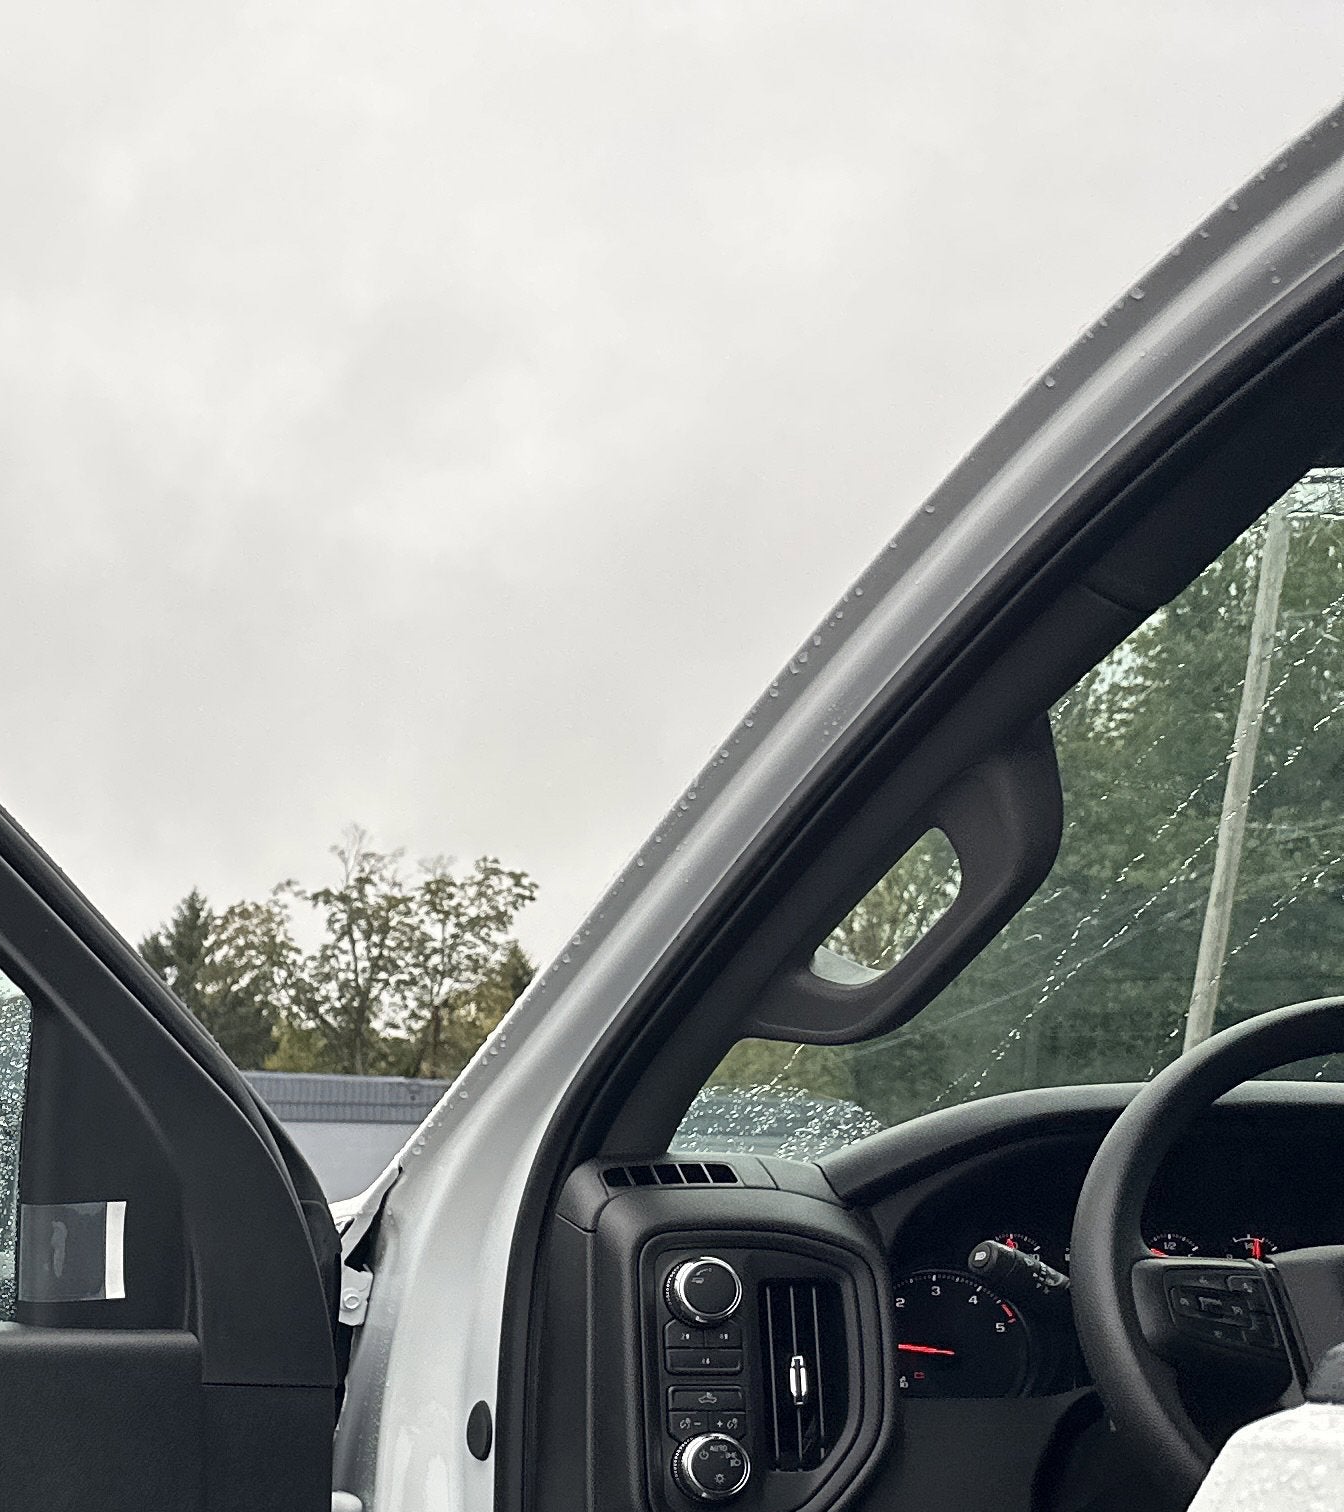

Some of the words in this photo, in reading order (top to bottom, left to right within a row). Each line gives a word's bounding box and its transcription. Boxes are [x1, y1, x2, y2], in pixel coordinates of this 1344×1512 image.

[930, 1285, 941, 1296] 3
[895, 1297, 906, 1308] 2
[968, 1295, 978, 1305] 4
[995, 1322, 1006, 1333] 5
[709, 1444, 728, 1452] AUTO
